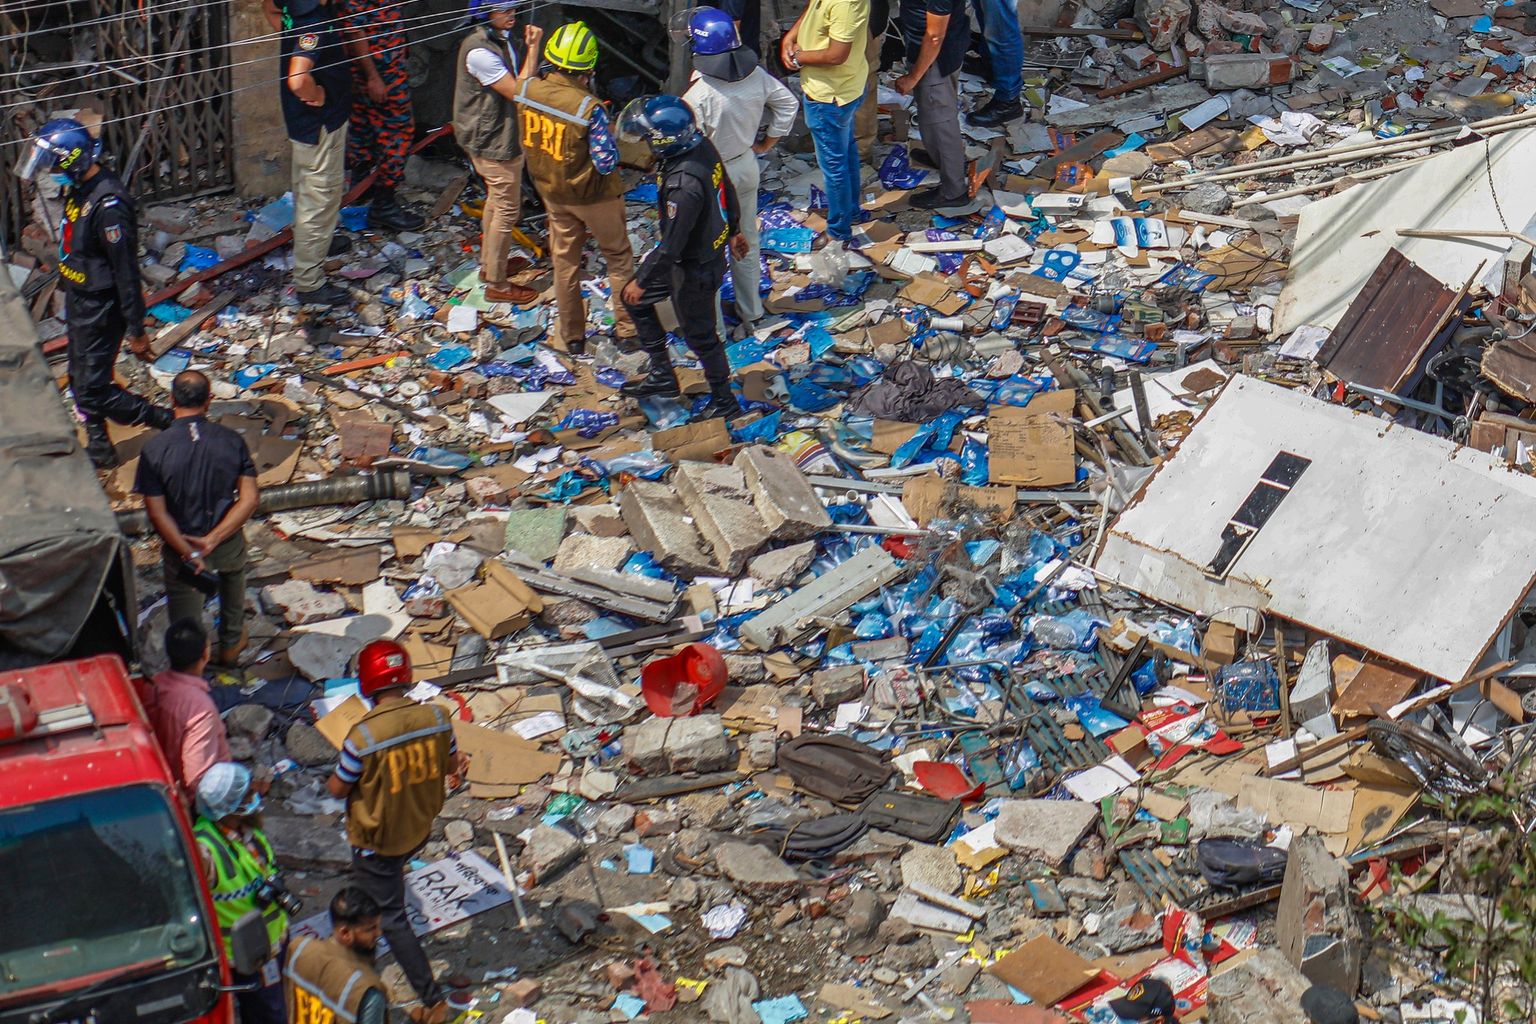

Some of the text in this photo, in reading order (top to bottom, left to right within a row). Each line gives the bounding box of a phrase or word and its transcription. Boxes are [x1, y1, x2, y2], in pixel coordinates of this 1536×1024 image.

[523, 109, 566, 161] PBI
[387, 739, 440, 794] PBI
[417, 870, 478, 910] RAK
